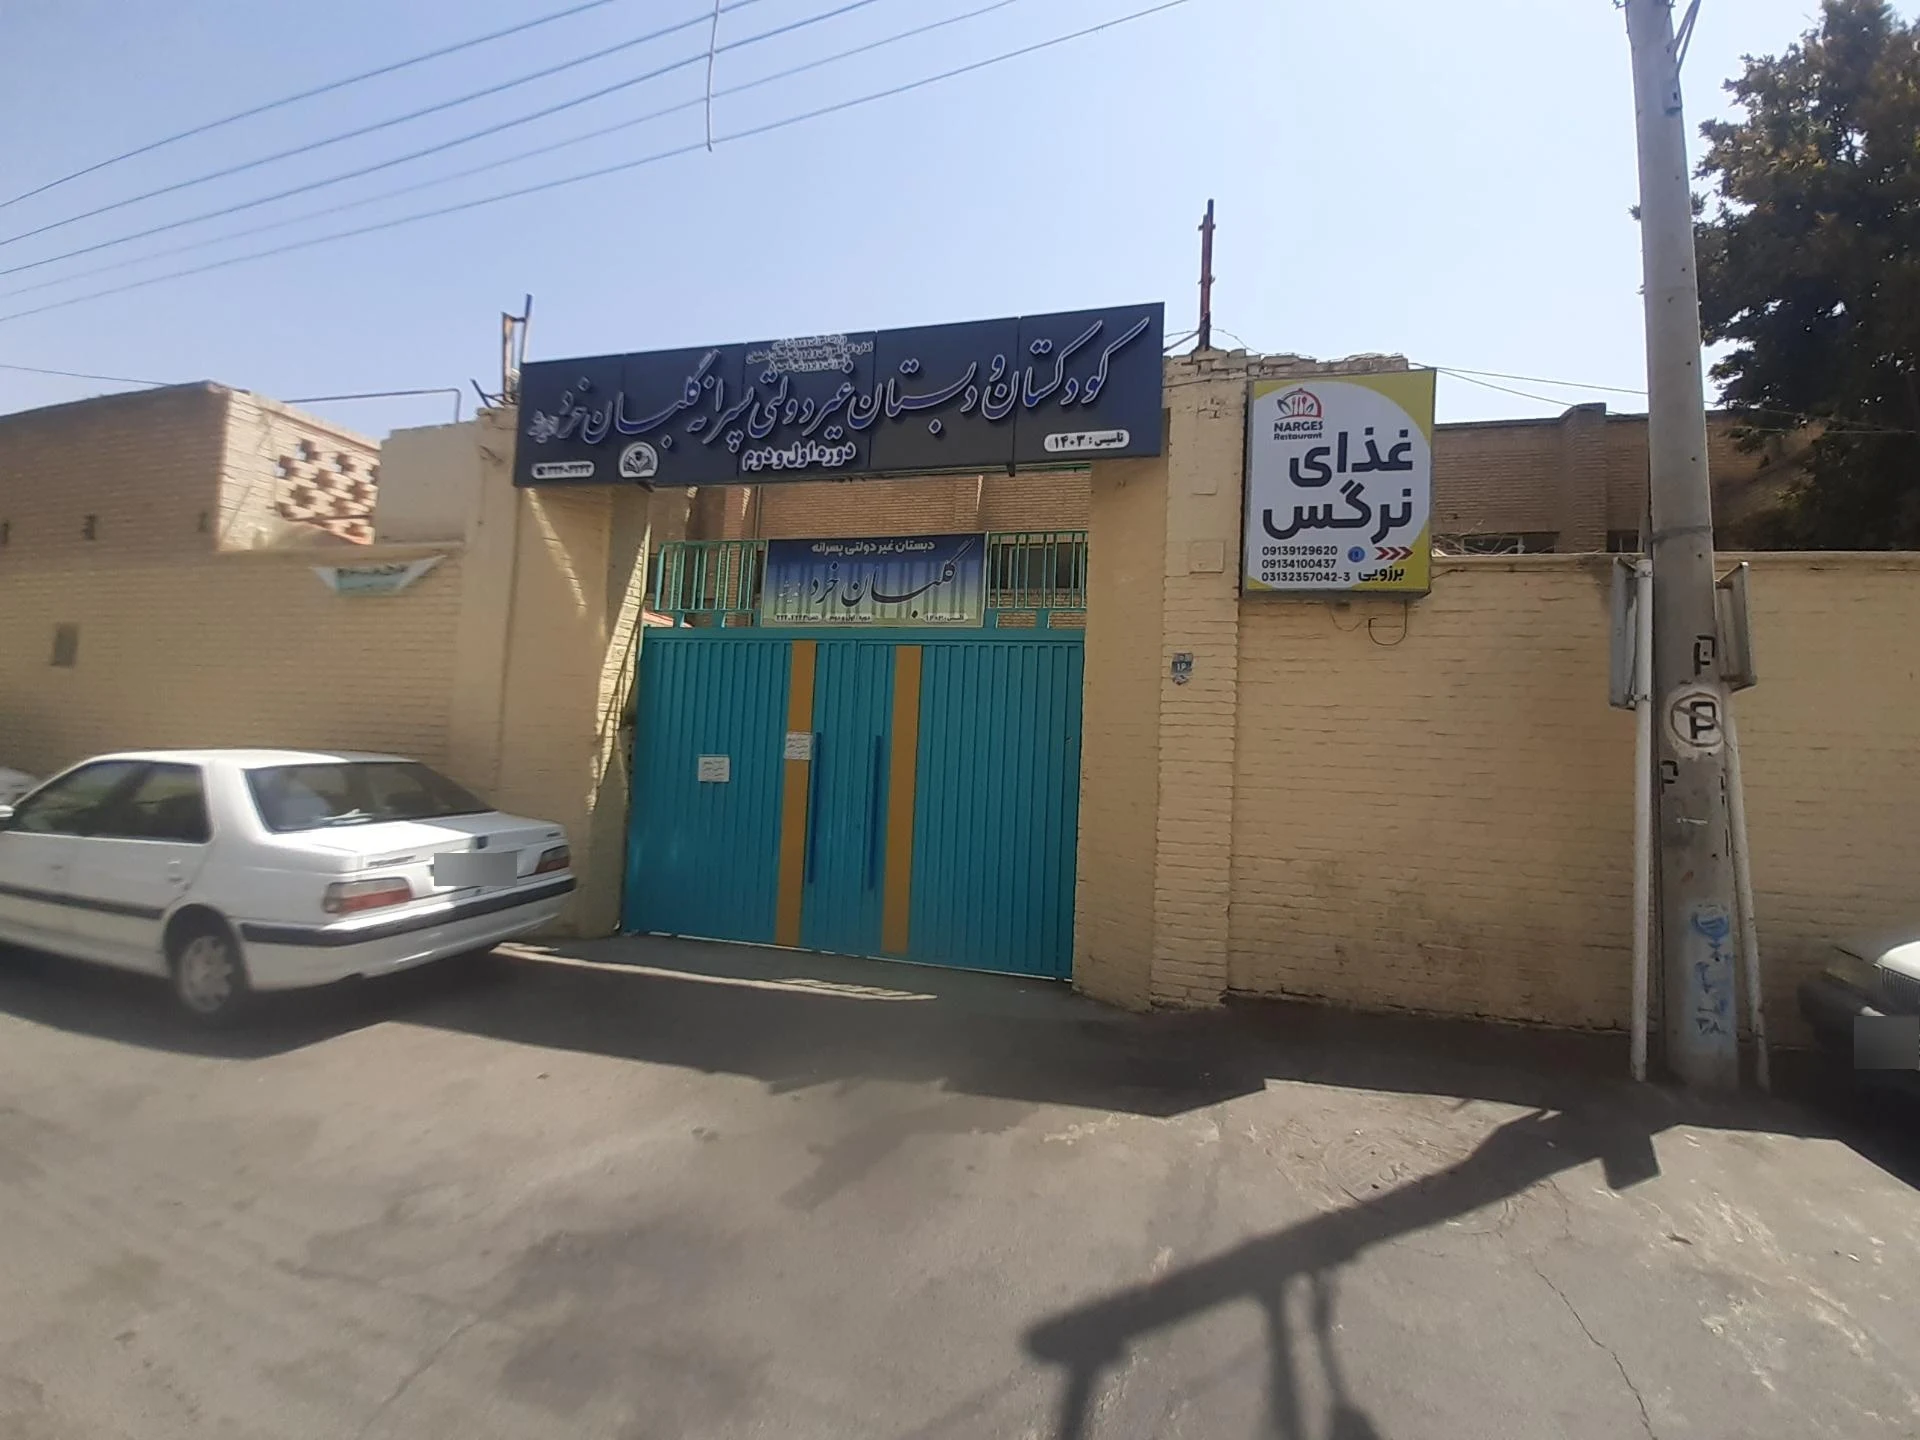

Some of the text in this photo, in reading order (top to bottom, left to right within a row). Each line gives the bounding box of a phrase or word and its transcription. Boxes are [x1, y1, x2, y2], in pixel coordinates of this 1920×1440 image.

[982, 315, 1149, 420] کودکستان
[989, 354, 1006, 382] و
[748, 369, 816, 439] دولتی
[802, 360, 855, 439] غیر
[847, 358, 979, 435] دبستان
[686, 374, 754, 453] پسرانه
[1273, 420, 1323, 432] NARGES
[1054, 434, 1086, 450] ۱۴۰۳
[1273, 432, 1323, 441] Restaurant
[742, 439, 857, 472] دوره اول و دوم
[1289, 427, 1413, 488] غذای
[1262, 479, 1412, 545] نرگس
[811, 539, 936, 557] دبستان غیر دولتی پسرانه
[1261, 545, 1338, 556] 09139129620
[1261, 558, 1337, 569] 09134100437
[1261, 571, 1350, 582] 03132357042-3
[1358, 565, 1405, 582] برزویی
